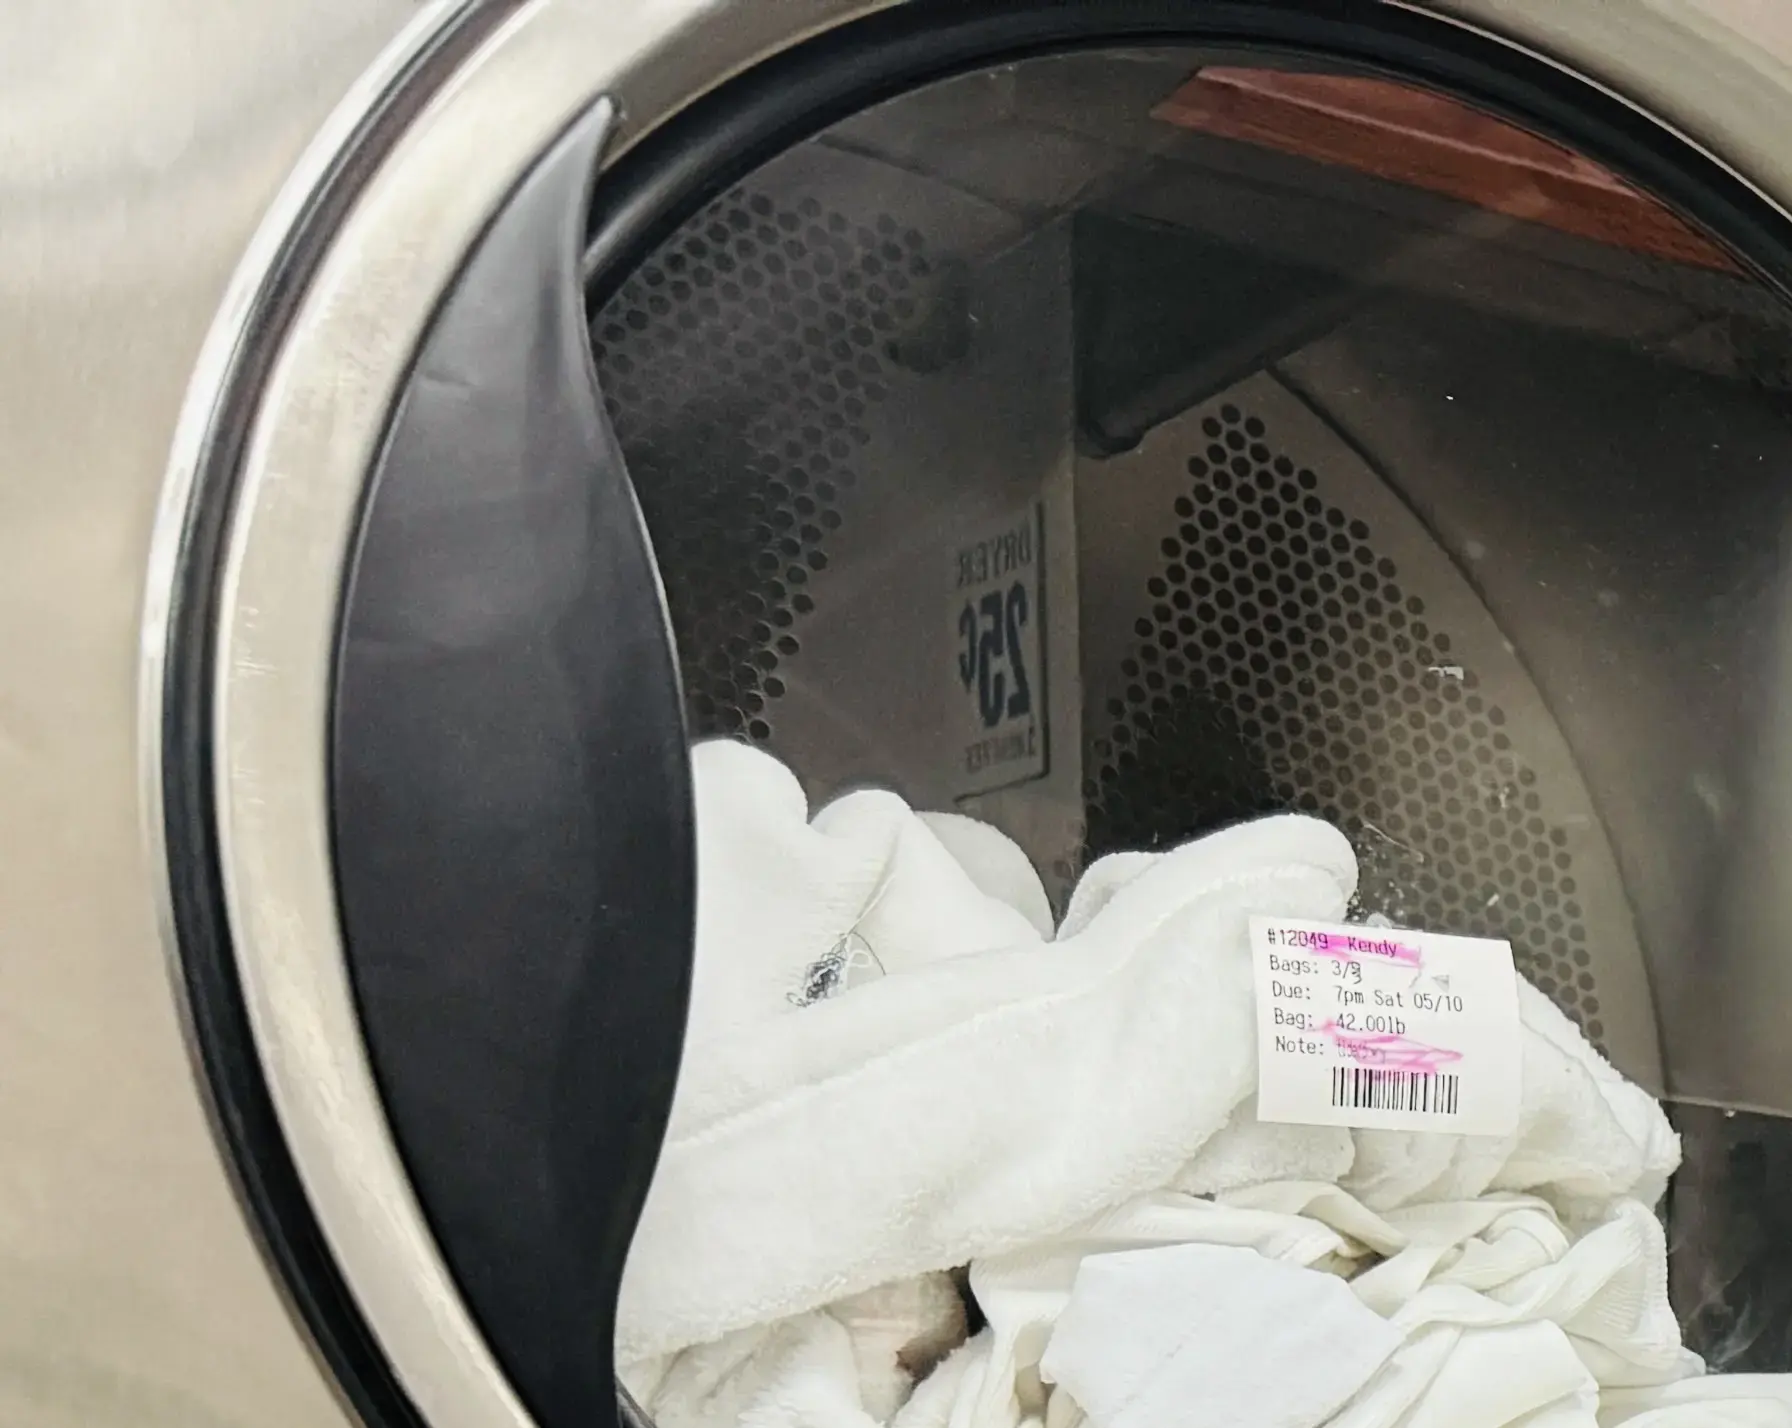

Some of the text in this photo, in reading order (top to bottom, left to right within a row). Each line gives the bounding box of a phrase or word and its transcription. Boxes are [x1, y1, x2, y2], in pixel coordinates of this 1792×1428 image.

[1267, 928, 1397, 958] #12049 Kendy
[1269, 954, 1319, 976] Bags:
[1272, 980, 1464, 1013] Due: 7pm Sat 05/10
[1274, 1007, 1406, 1035] Bag: 42.00lb
[1275, 1036, 1324, 1056] Note:
